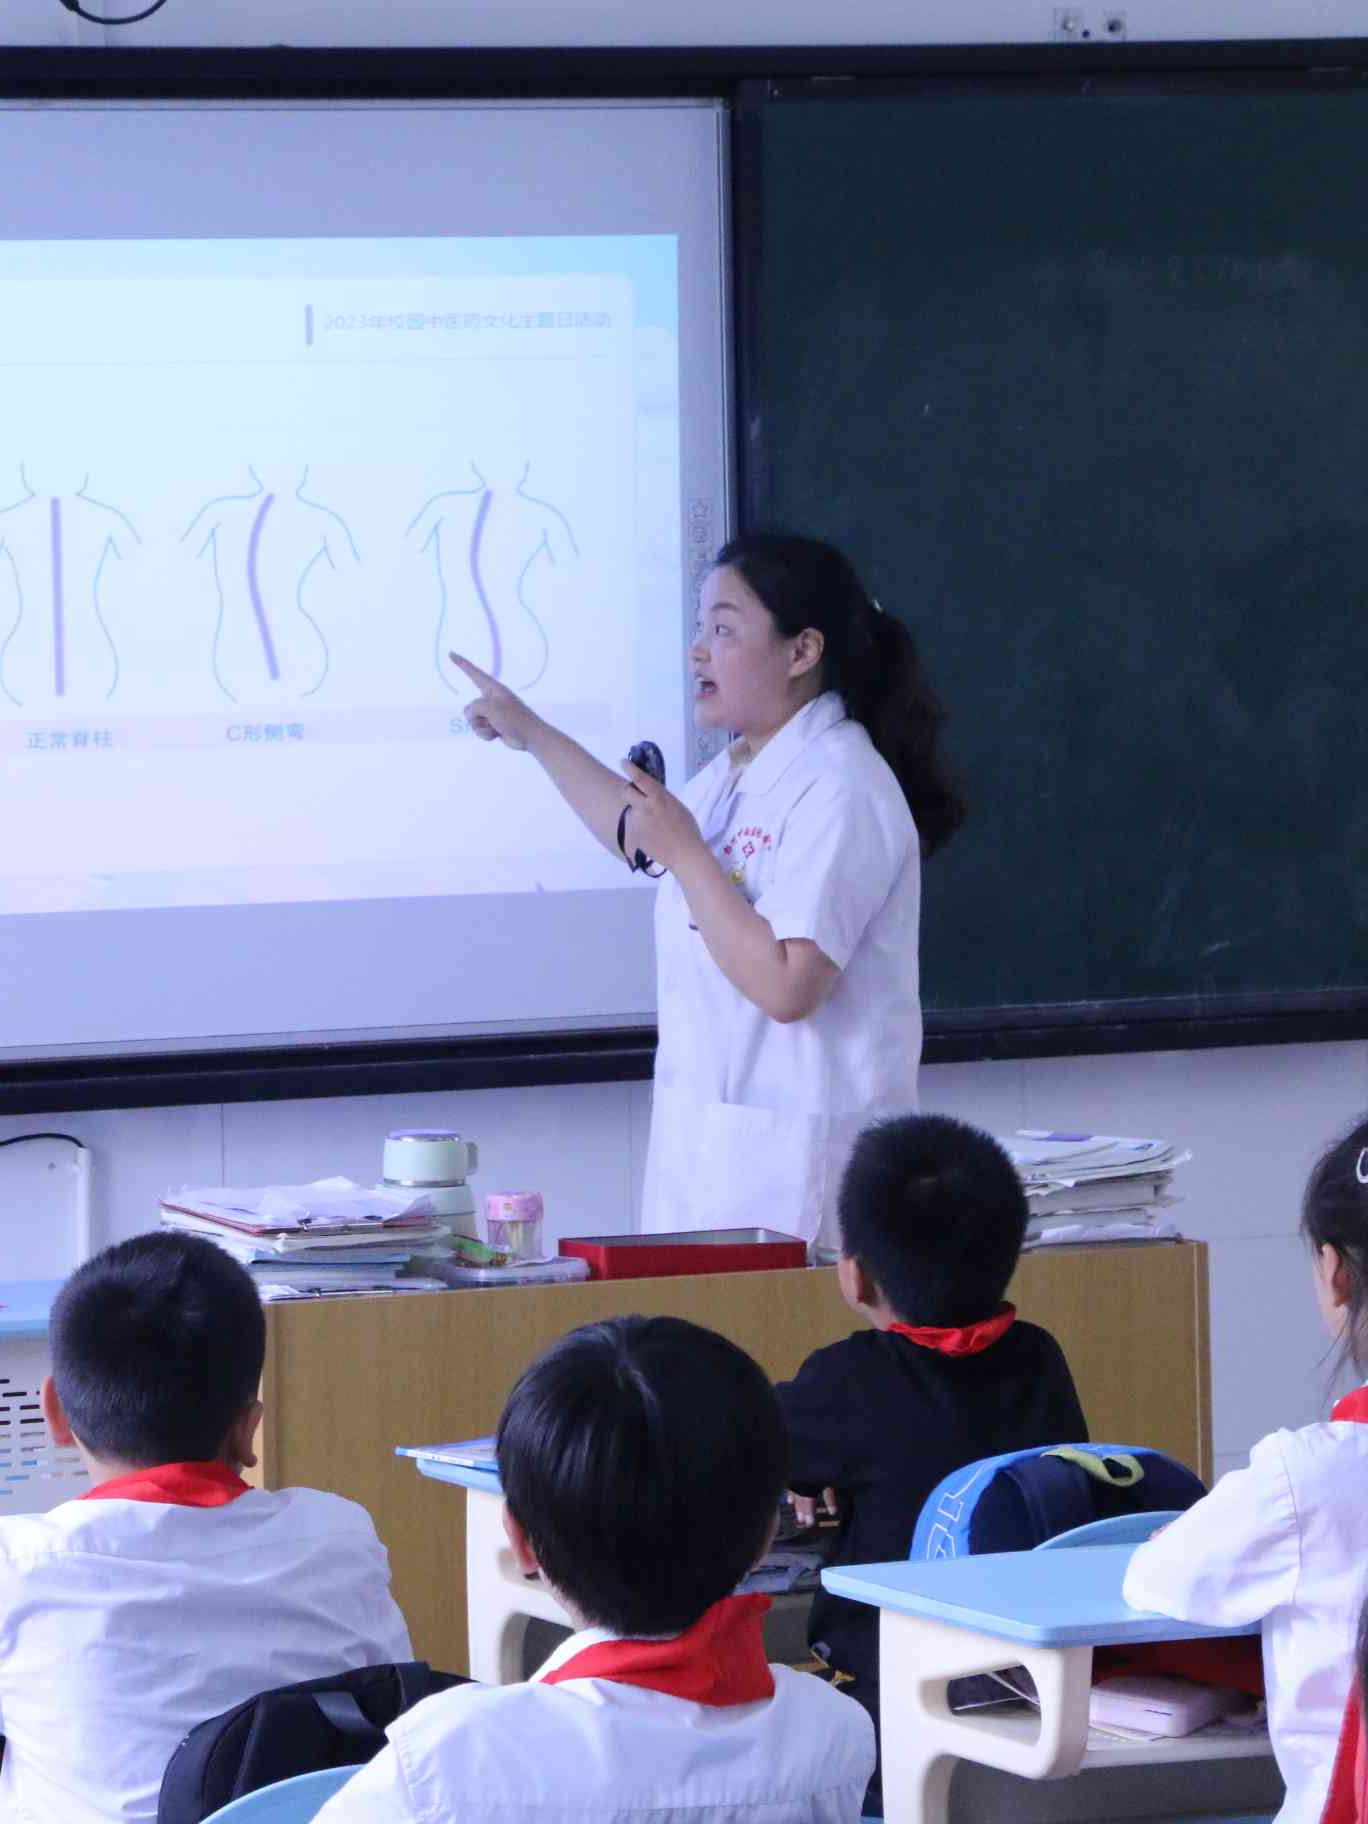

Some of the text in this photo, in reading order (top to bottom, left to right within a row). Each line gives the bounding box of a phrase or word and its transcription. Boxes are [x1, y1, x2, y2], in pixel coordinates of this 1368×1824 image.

[25, 728, 113, 749] 正常脊柱
[225, 722, 306, 744] C形侧弯
